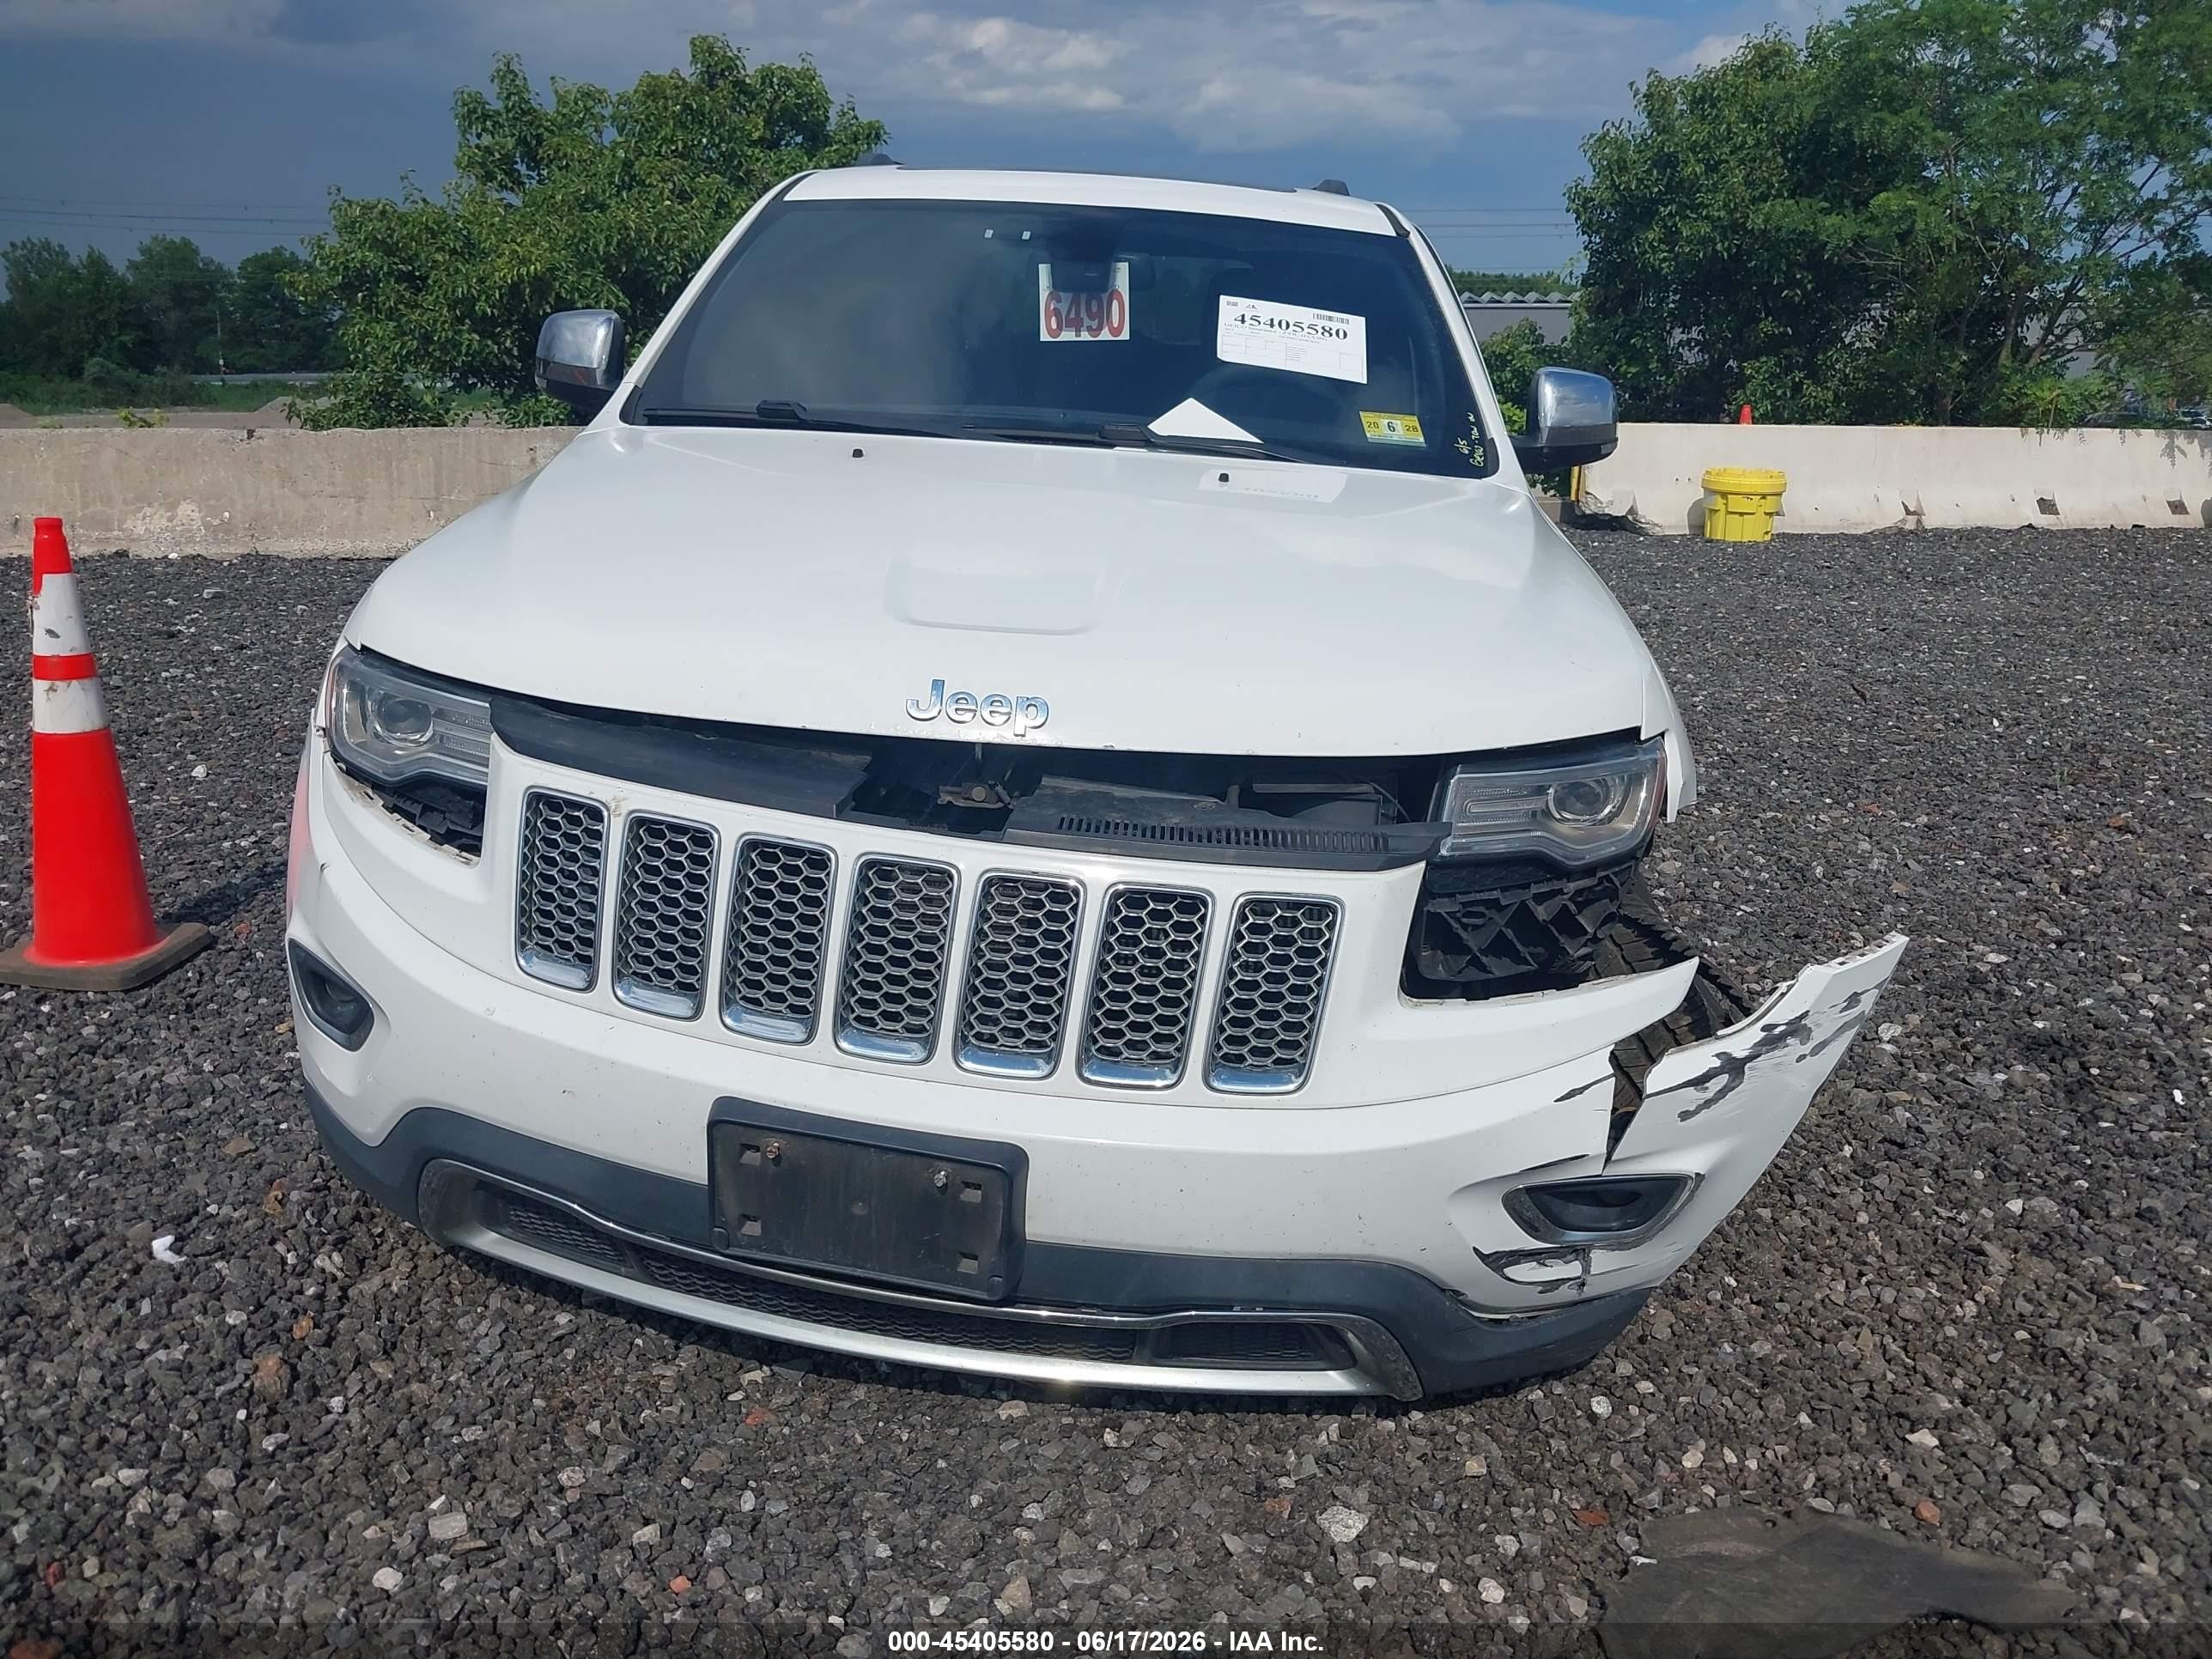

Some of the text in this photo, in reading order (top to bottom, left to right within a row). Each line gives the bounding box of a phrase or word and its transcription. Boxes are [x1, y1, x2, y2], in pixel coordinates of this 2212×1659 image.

[1044, 289, 1125, 338] 6490
[1233, 313, 1348, 340] 45405580
[1366, 421, 1419, 433] 20 6 28
[905, 678, 1049, 737] Jeep
